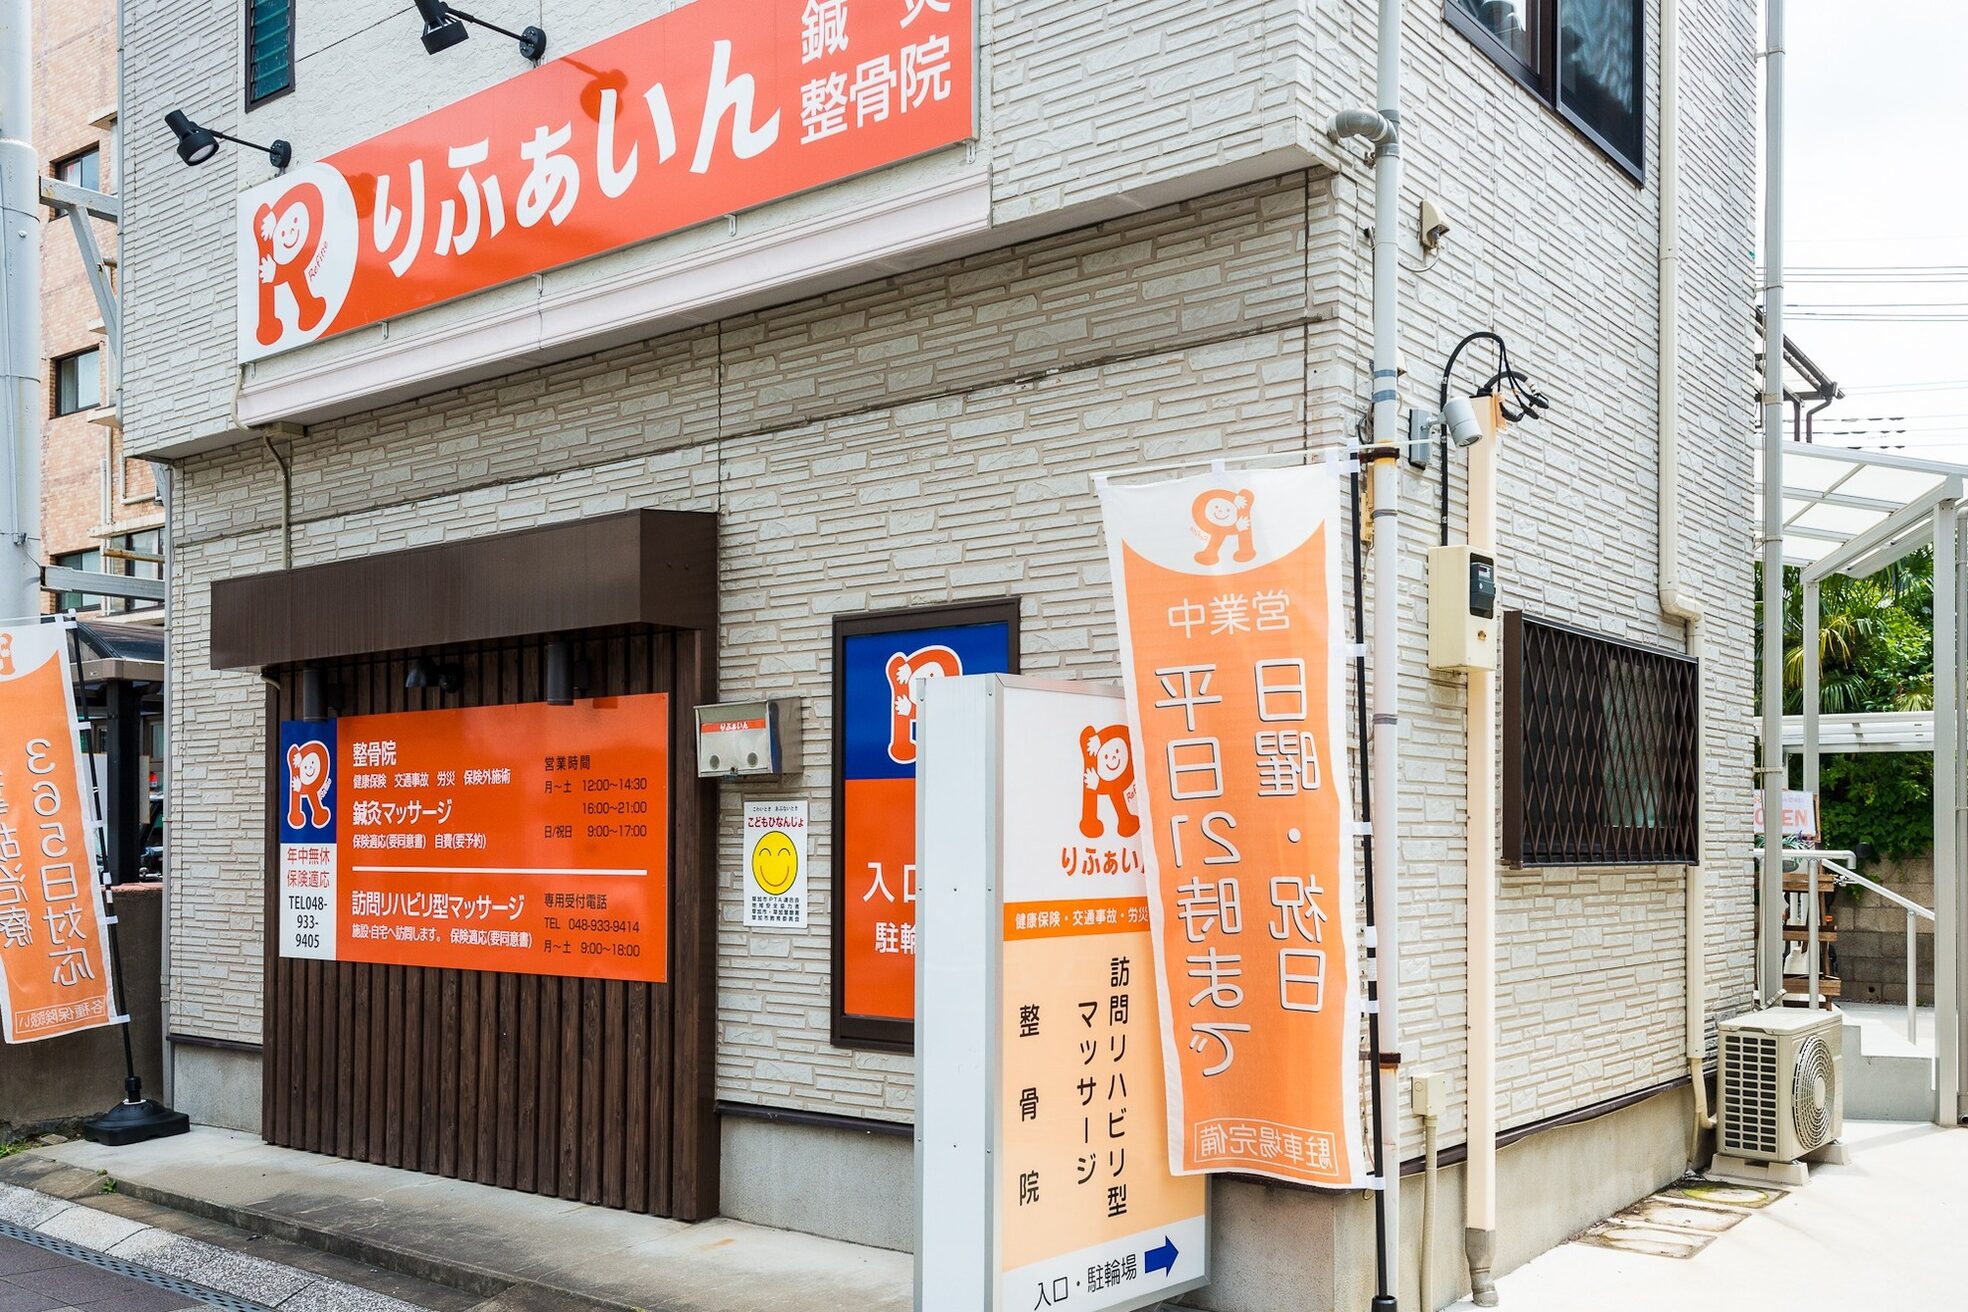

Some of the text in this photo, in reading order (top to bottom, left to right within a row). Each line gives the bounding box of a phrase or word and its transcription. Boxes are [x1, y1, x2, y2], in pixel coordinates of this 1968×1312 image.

[800, 34, 951, 145] 整骨院
[352, 740, 397, 767] 整骨院
[544, 755, 591, 772] 営業時間
[353, 767, 511, 789] 健康保険 交通事故 労災 保険外施術
[352, 798, 453, 826] 鍼灸マッサージ
[748, 816, 804, 828] こどもひなんじょ
[1754, 808, 1808, 828] OEN
[287, 847, 330, 865] 年中無休
[287, 870, 330, 888] 保険適応
[352, 890, 525, 921] 訪問リハビリ型マッサージ
[544, 893, 607, 910] 専用受付電話
[296, 914, 319, 929] 933-
[544, 917, 640, 933] TEL 048-933-9414
[295, 933, 320, 949] 9405
[1077, 1001, 1098, 1186] マッサージ
[1107, 956, 1130, 1218] 訪問リハビリ型
[1019, 1003, 1040, 1207] 整骨院
[1034, 1253, 1137, 1311] 入口・駐輪場
